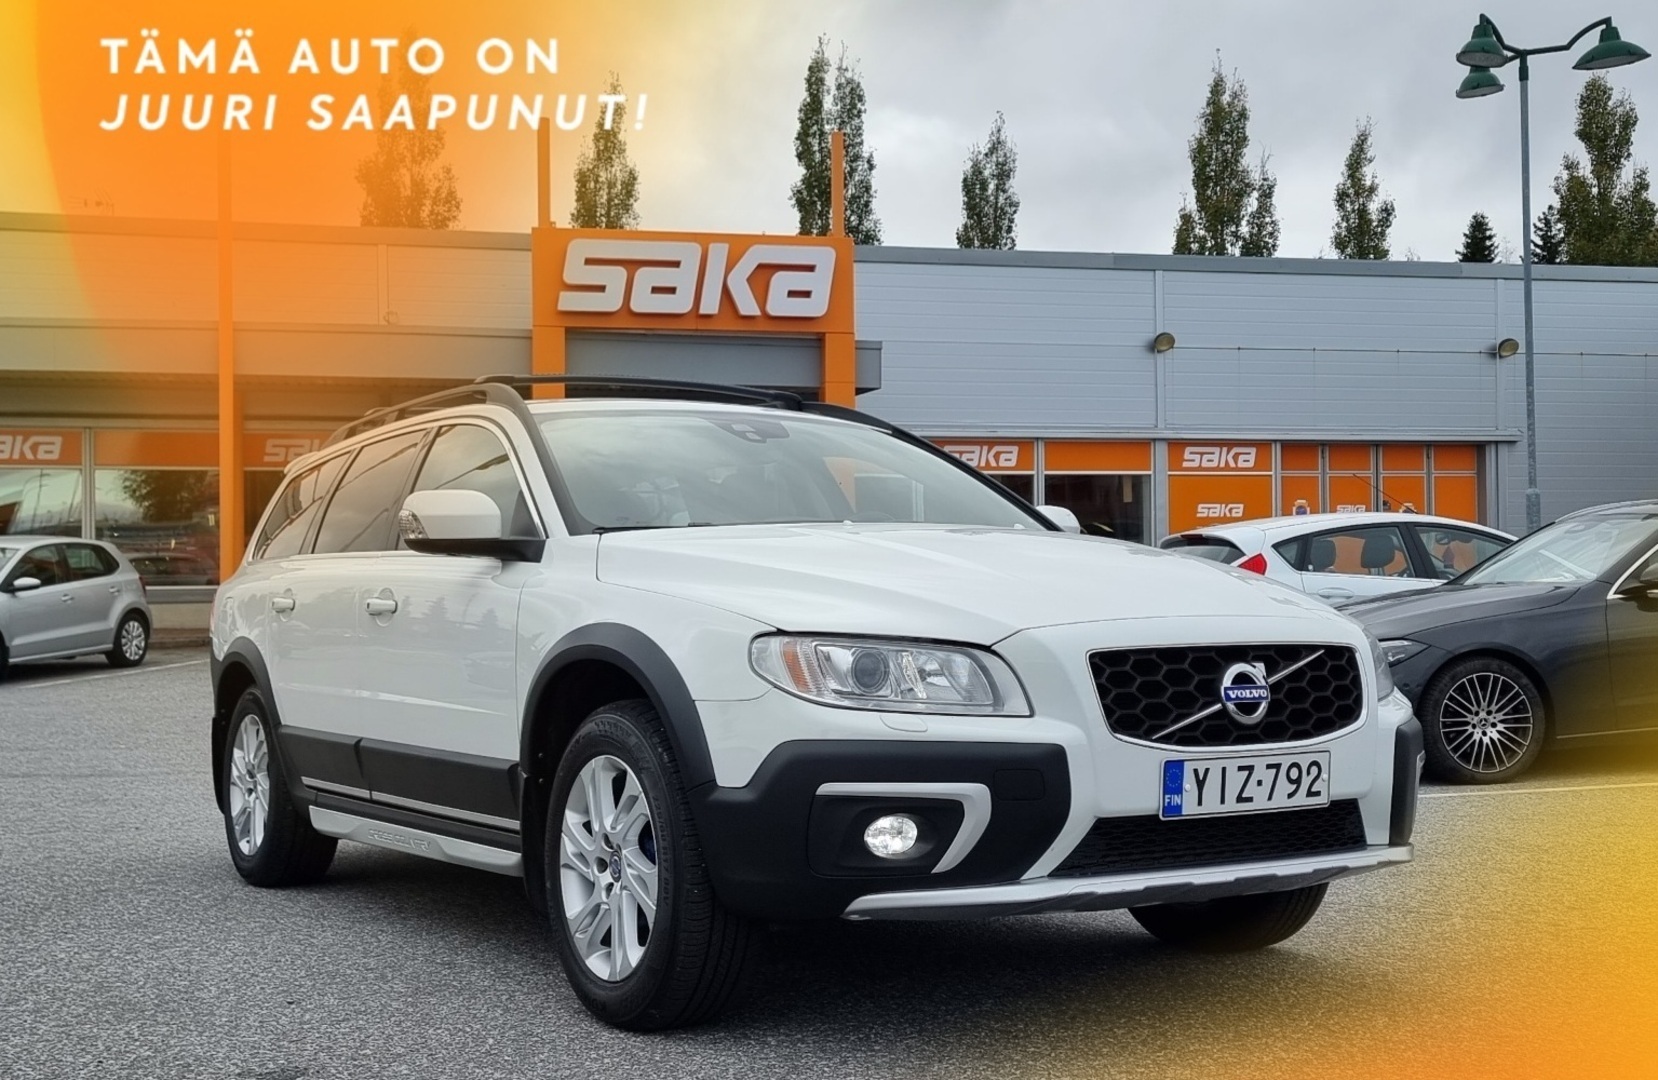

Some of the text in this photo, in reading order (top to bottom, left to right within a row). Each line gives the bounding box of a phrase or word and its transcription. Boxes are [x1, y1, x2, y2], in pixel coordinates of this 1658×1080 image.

[1226, 688, 1268, 699] VOLVO
[1192, 759, 1323, 807] YIZ-792
[1164, 794, 1182, 807] FIN
